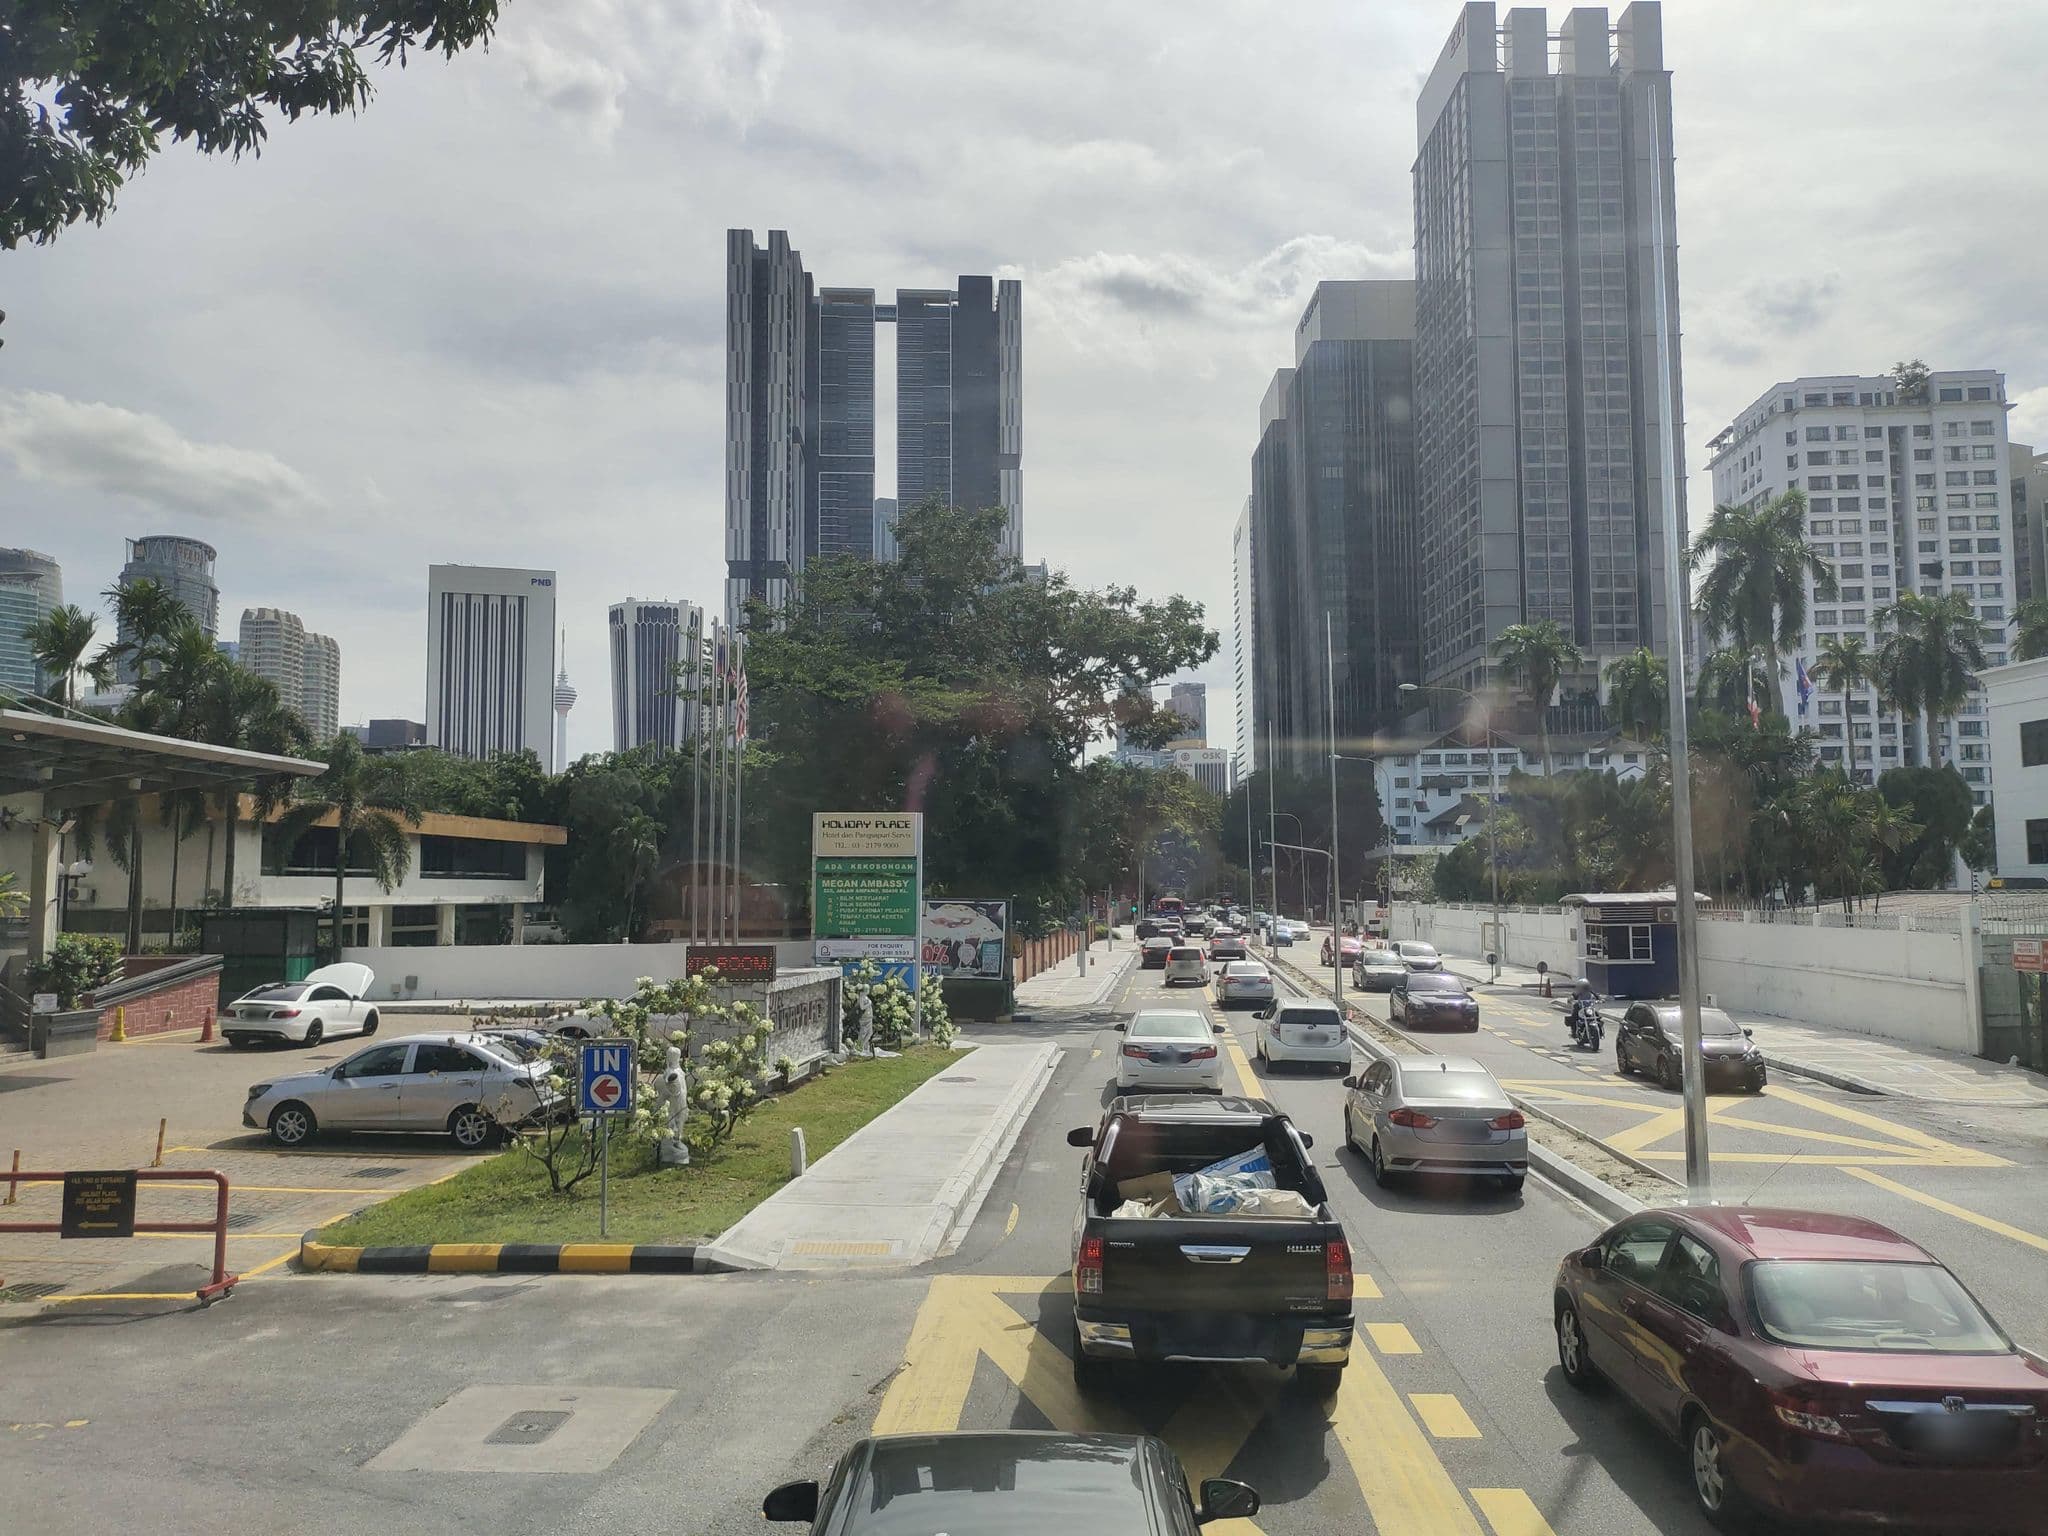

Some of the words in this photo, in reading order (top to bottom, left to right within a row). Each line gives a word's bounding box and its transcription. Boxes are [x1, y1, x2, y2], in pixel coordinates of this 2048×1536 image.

[530, 578, 552, 587] PNB
[1202, 751, 1221, 760] OSK
[822, 820, 872, 829] HOLIDAY
[875, 820, 911, 829] PLACE
[822, 879, 858, 888] MEGAN
[860, 879, 910, 888] AMBASSY
[593, 1049, 620, 1072] IN
[1286, 1244, 1322, 1253] HILUX
